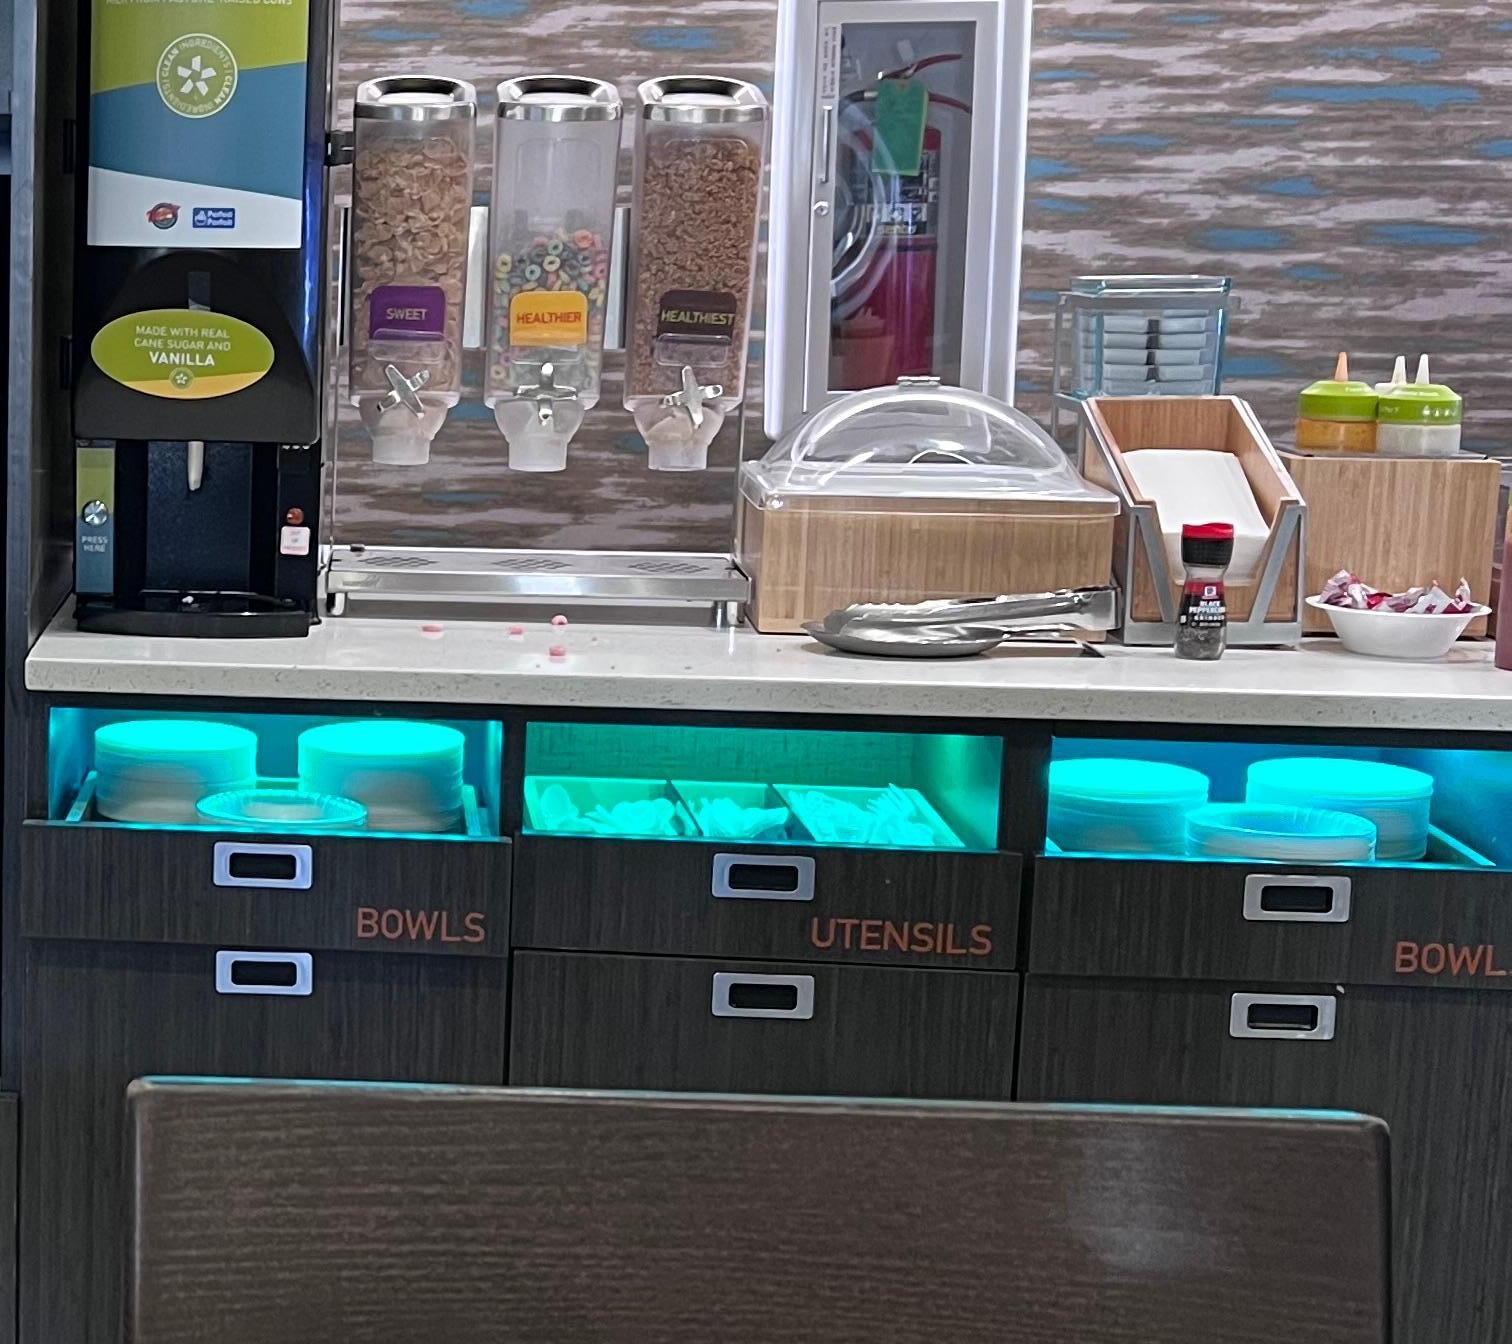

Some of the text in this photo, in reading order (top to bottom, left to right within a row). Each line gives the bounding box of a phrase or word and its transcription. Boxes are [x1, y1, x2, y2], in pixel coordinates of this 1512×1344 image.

[386, 307, 428, 321] SWEET
[516, 311, 582, 324] HEALTHIER
[661, 309, 736, 326] HEALTHIEST
[135, 325, 230, 339] MADE WITH REAL
[134, 338, 232, 351] CANE SUGAR AND
[149, 351, 215, 366] VANILLA
[81, 535, 108, 544] PRESS
[356, 906, 485, 943] BOWLS
[810, 916, 993, 956] UTENSILS
[1395, 941, 1512, 977] BOWL
